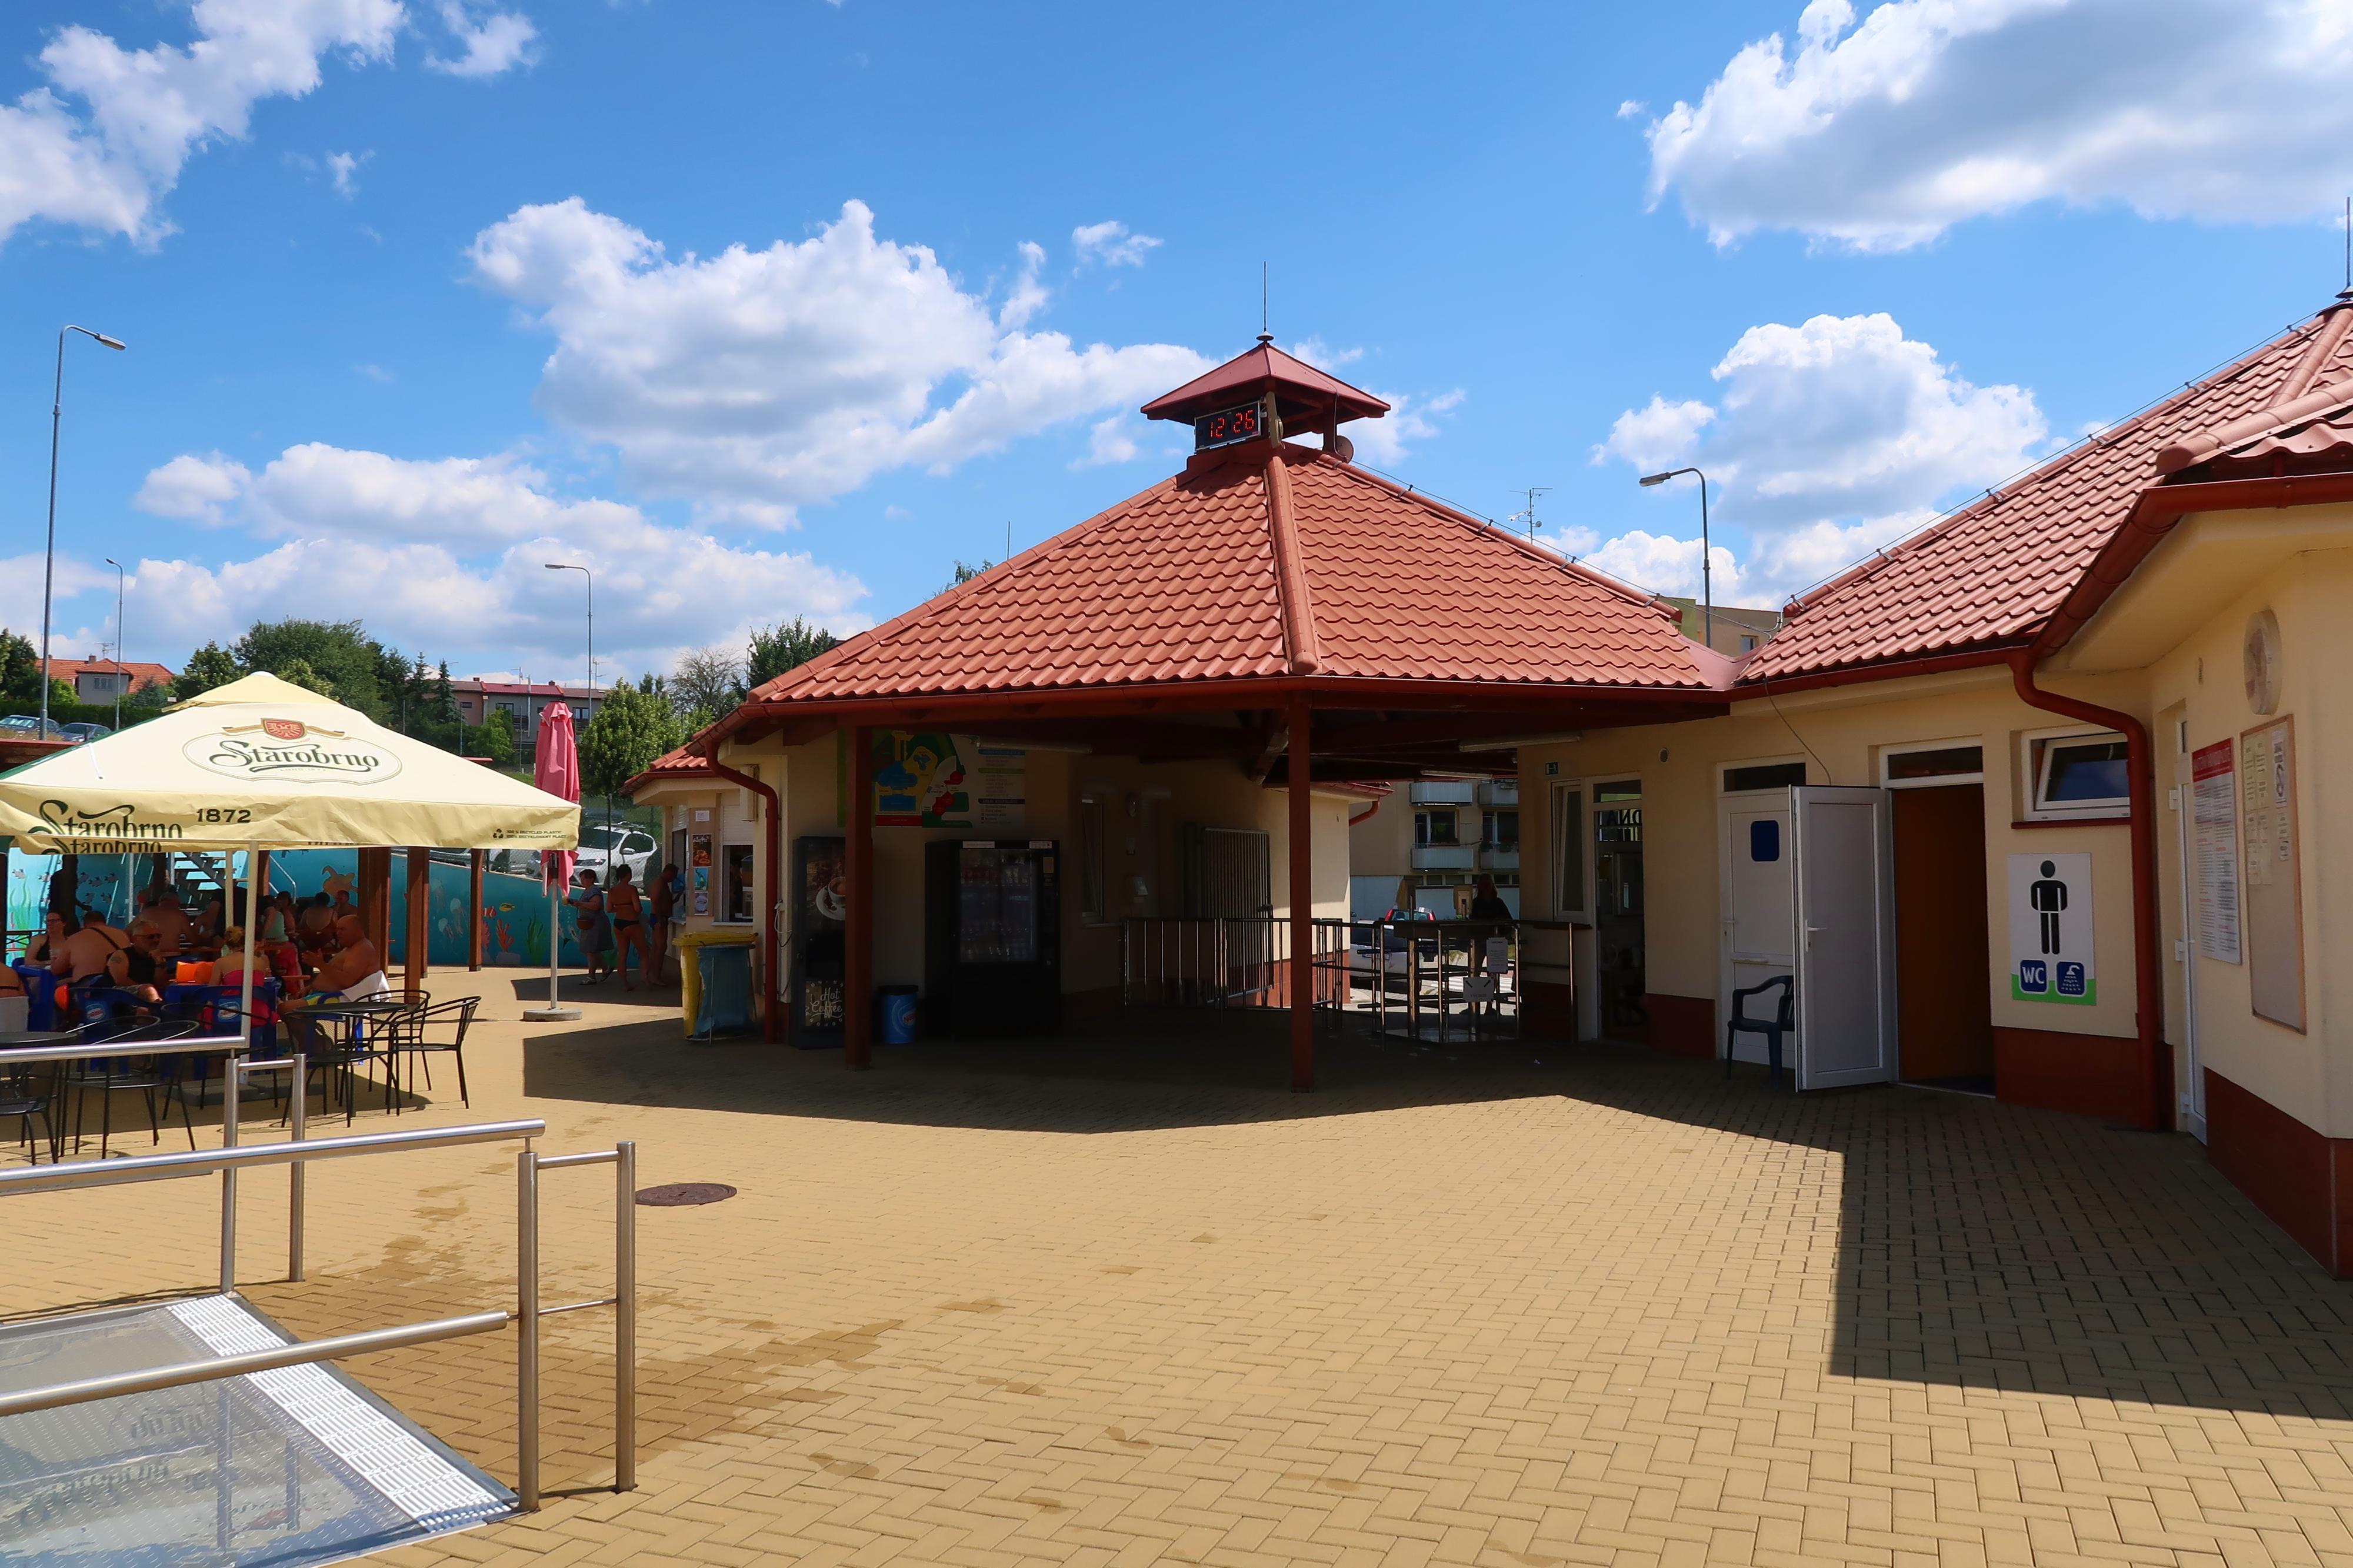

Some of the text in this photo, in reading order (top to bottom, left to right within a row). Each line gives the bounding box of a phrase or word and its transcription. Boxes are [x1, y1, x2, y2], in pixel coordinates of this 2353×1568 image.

[1210, 409, 1254, 438] 12 26
[209, 740, 380, 768] Starobrno
[196, 808, 252, 823] 1872
[2022, 966, 2045, 984] WC
[820, 987, 841, 1002] Hot
[810, 1000, 842, 1018] Coffee
